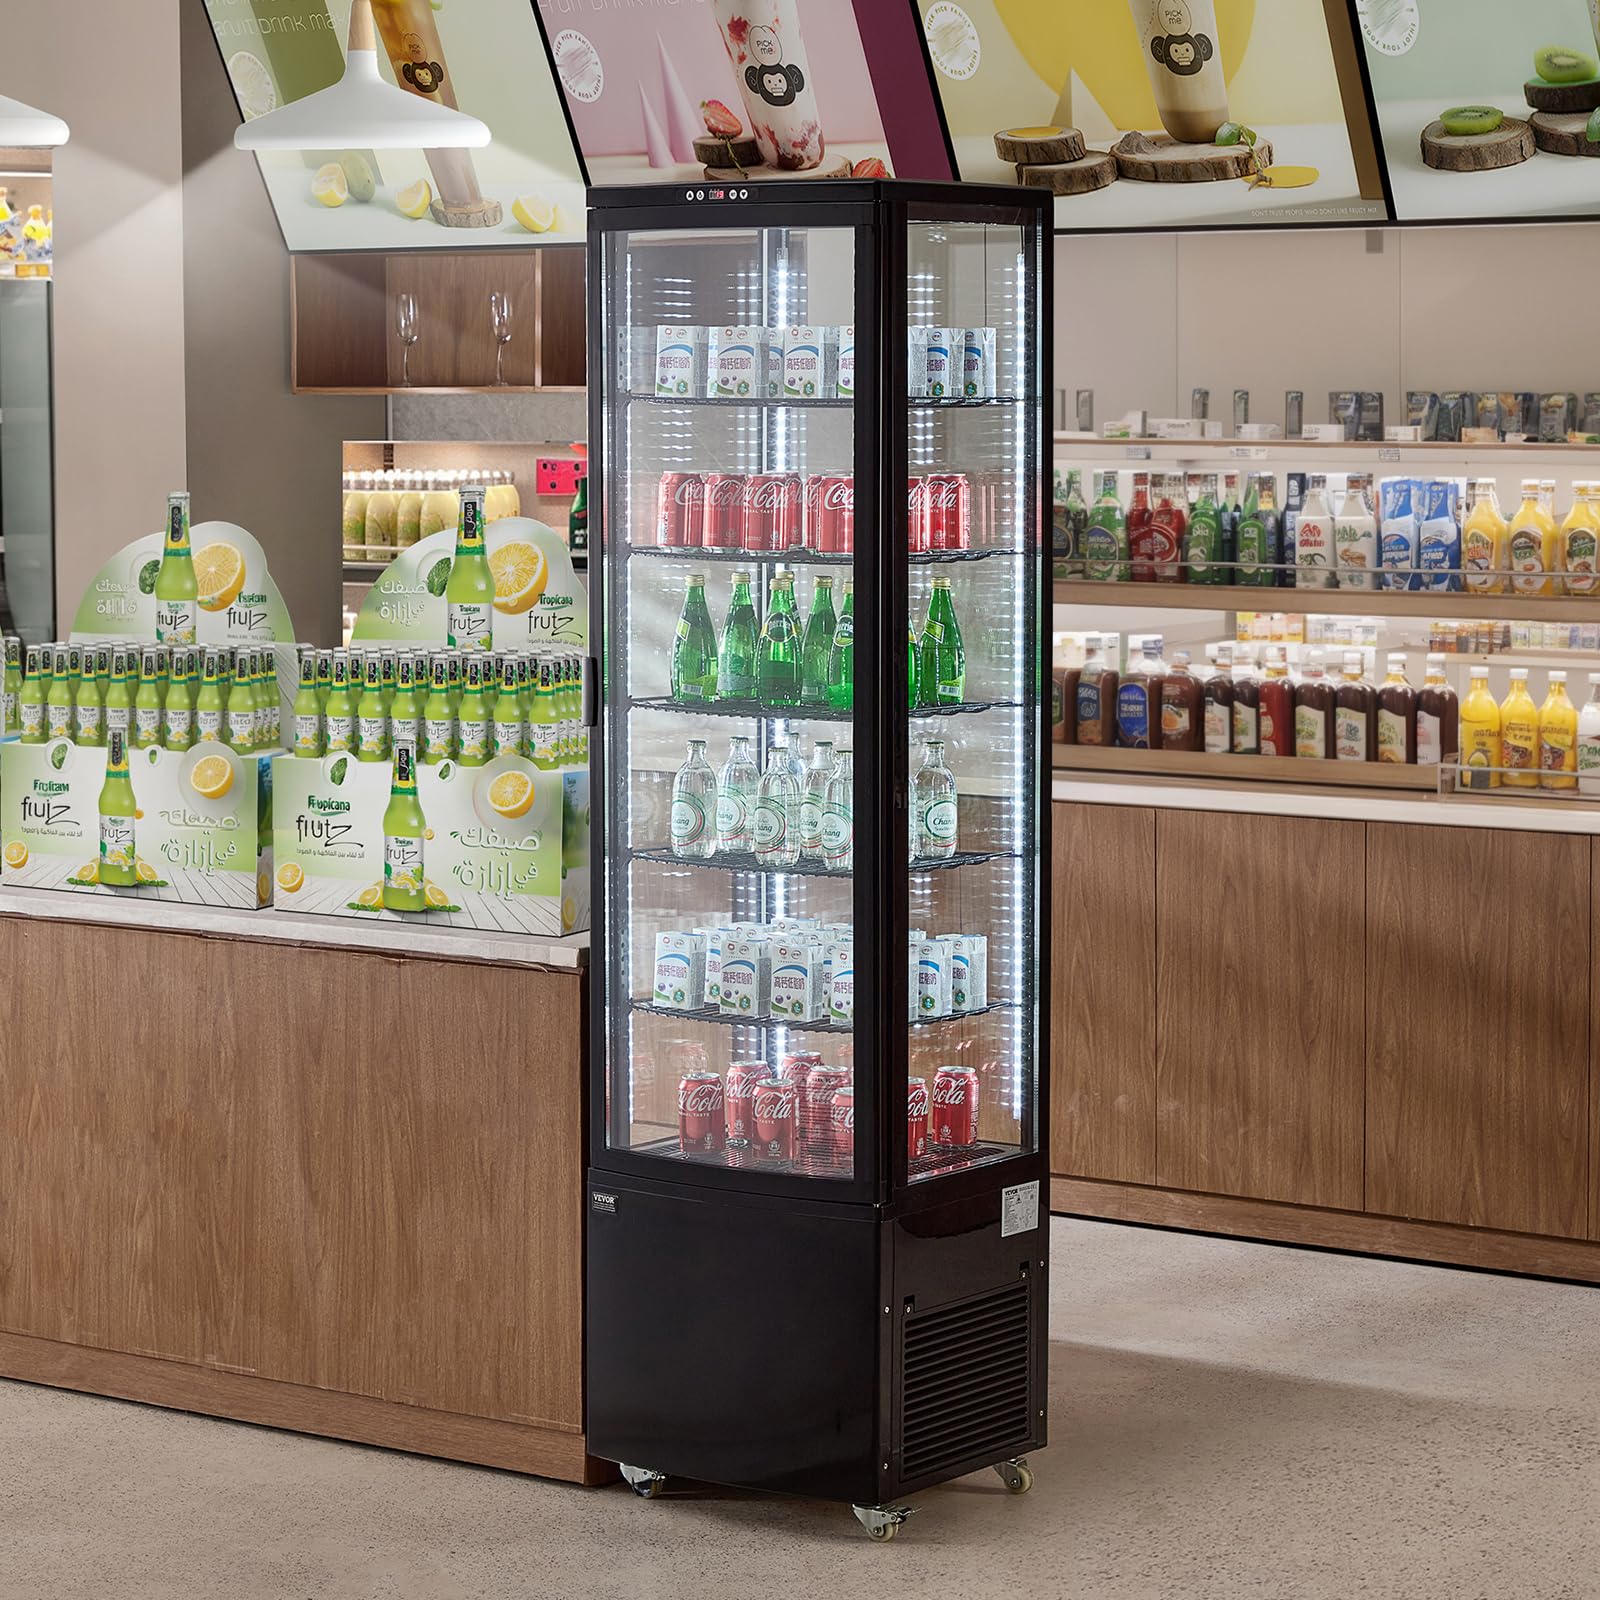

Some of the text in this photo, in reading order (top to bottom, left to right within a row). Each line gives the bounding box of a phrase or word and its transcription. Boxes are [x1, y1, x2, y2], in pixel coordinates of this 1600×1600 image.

[756, 40, 773, 48] PICK
[659, 356, 690, 368] 高钙低脂奶
[720, 357, 751, 370] 高钙低脂奶
[786, 357, 816, 370] 高钙低脂奶
[538, 594, 573, 606] Tropicana
[528, 610, 583, 638] frutz
[460, 827, 540, 856] صيفك
[656, 964, 687, 979] 高钙低脂奶
[722, 971, 752, 985] 高钙低脂奶
[774, 976, 805, 990] 高钙低脂奶
[686, 1084, 723, 1112] Cola
[933, 1077, 968, 1105] Cola
[754, 1090, 792, 1119] Cola
